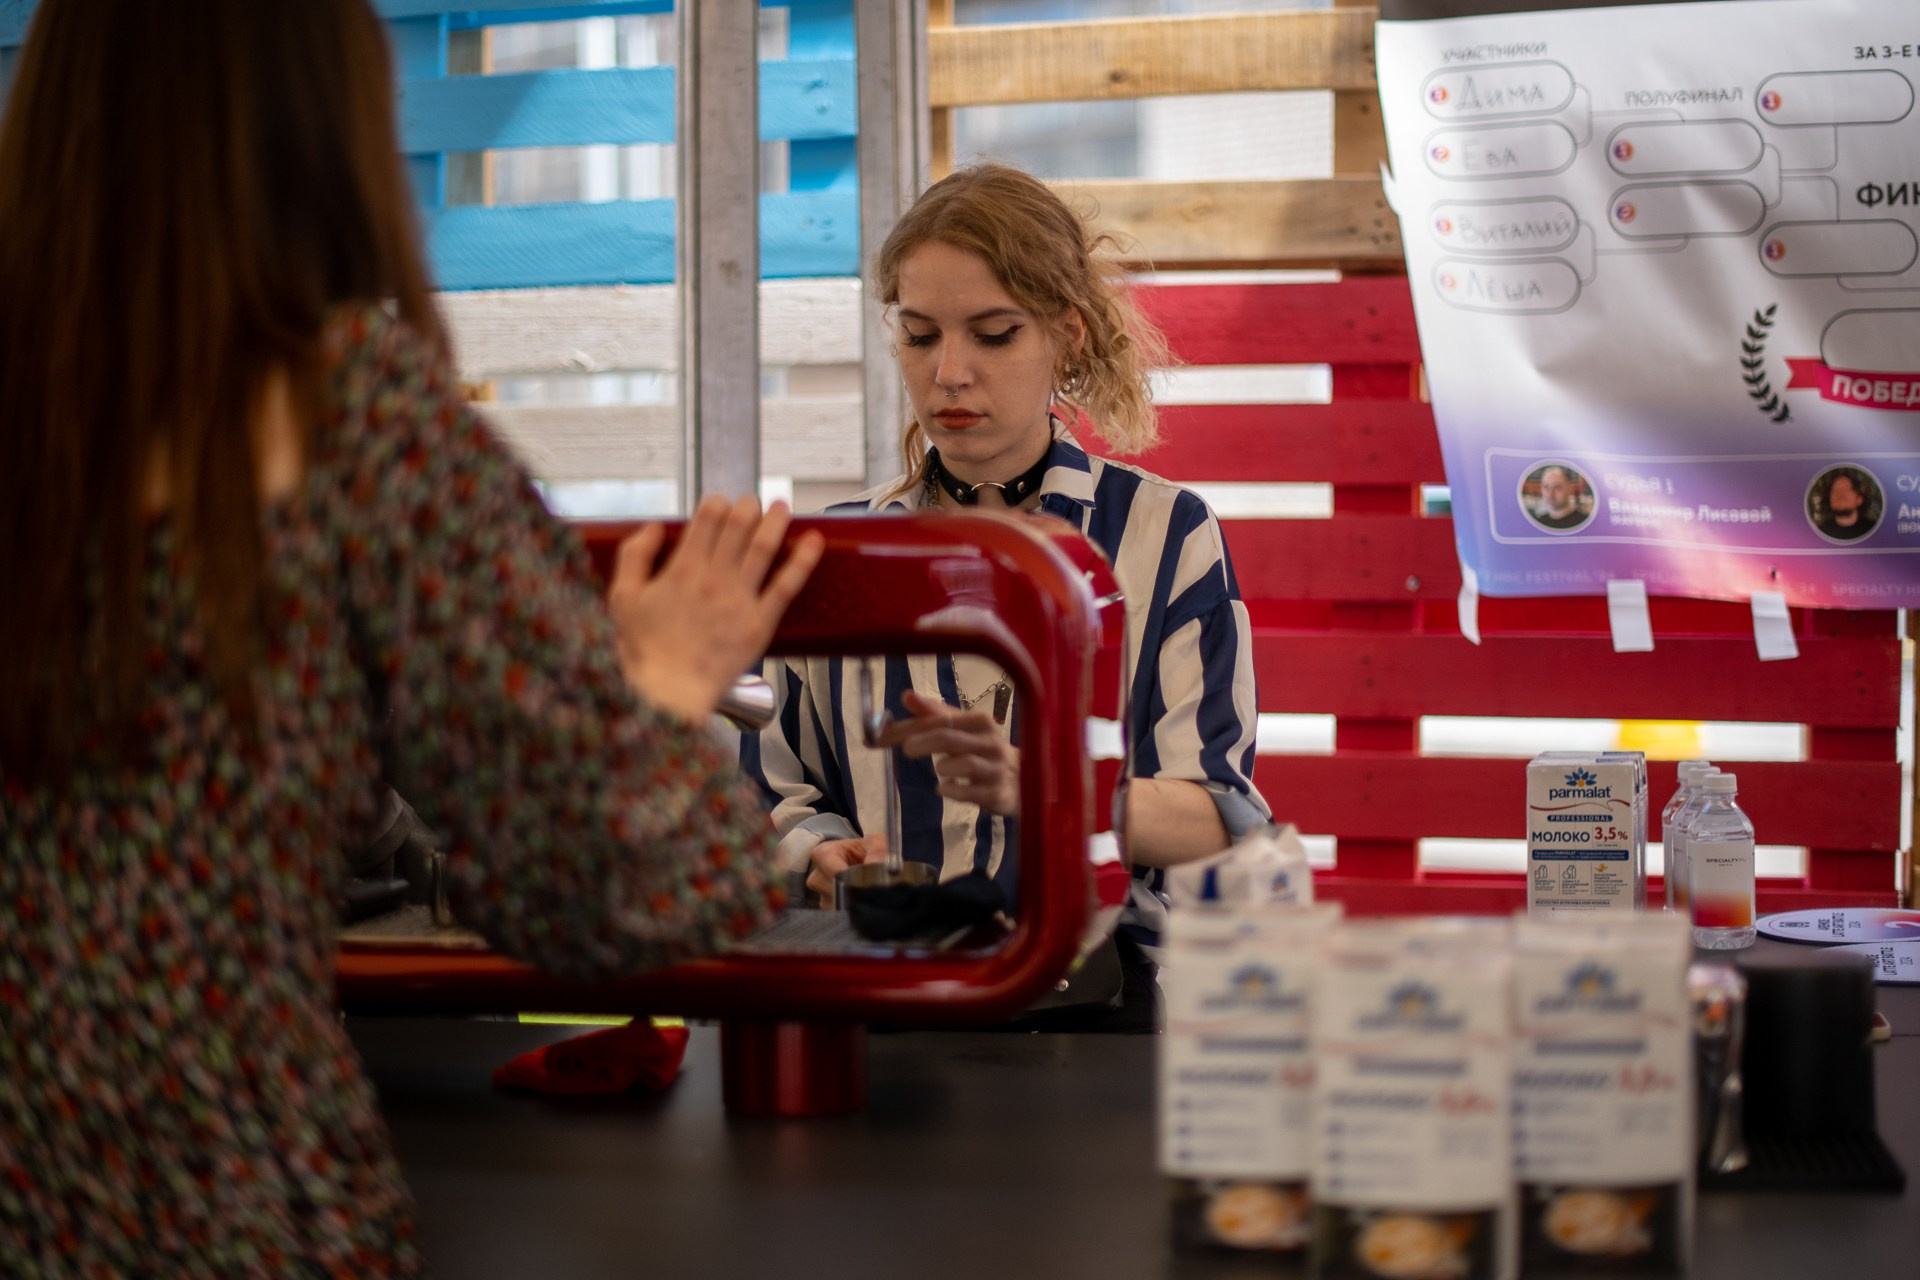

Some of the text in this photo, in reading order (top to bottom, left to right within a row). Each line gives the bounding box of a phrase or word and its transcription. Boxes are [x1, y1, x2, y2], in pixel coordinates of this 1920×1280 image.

[1854, 45, 1877, 60] ЗА
[1624, 87, 1743, 107] ПОЛУФИНАЛ
[1896, 474, 1920, 492] СУ
[1698, 504, 1773, 523] Лисовой
[1549, 786, 1611, 800] parmalat
[1532, 831, 1591, 842] МОЛОКО
